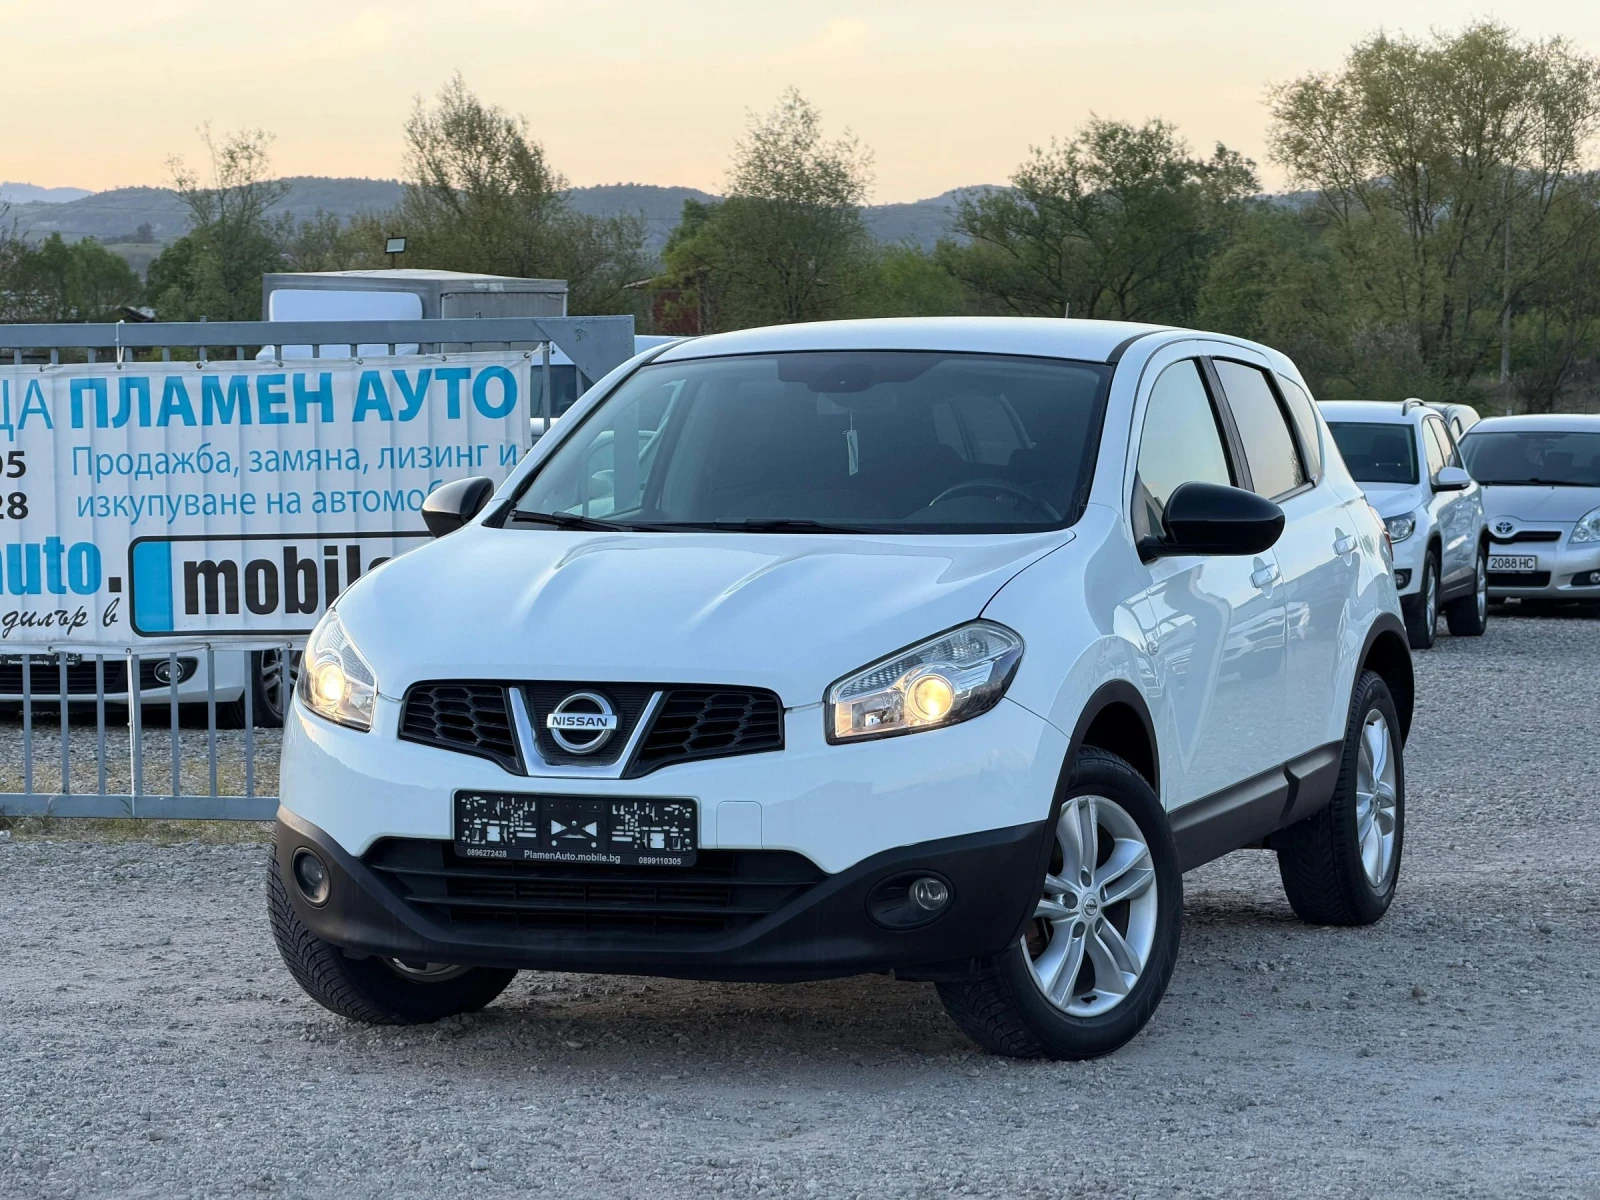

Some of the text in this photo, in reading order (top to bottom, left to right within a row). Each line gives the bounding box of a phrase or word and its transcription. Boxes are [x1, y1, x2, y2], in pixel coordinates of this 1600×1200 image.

[70, 373, 334, 429] ПЛАМЕН
[352, 365, 518, 422] АУТО
[0, 450, 27, 479] 5
[72, 442, 517, 484] Продажба, замяна, лизинг и
[0, 491, 29, 520] 8
[77, 491, 257, 526] изкупуване
[267, 490, 302, 515] на
[1491, 557, 1517, 569] 2088
[183, 544, 392, 615] mobil
[2, 605, 89, 639] дилър
[552, 716, 608, 727] NISSAN
[523, 850, 621, 864] PlamenAuto.mobile.bg
